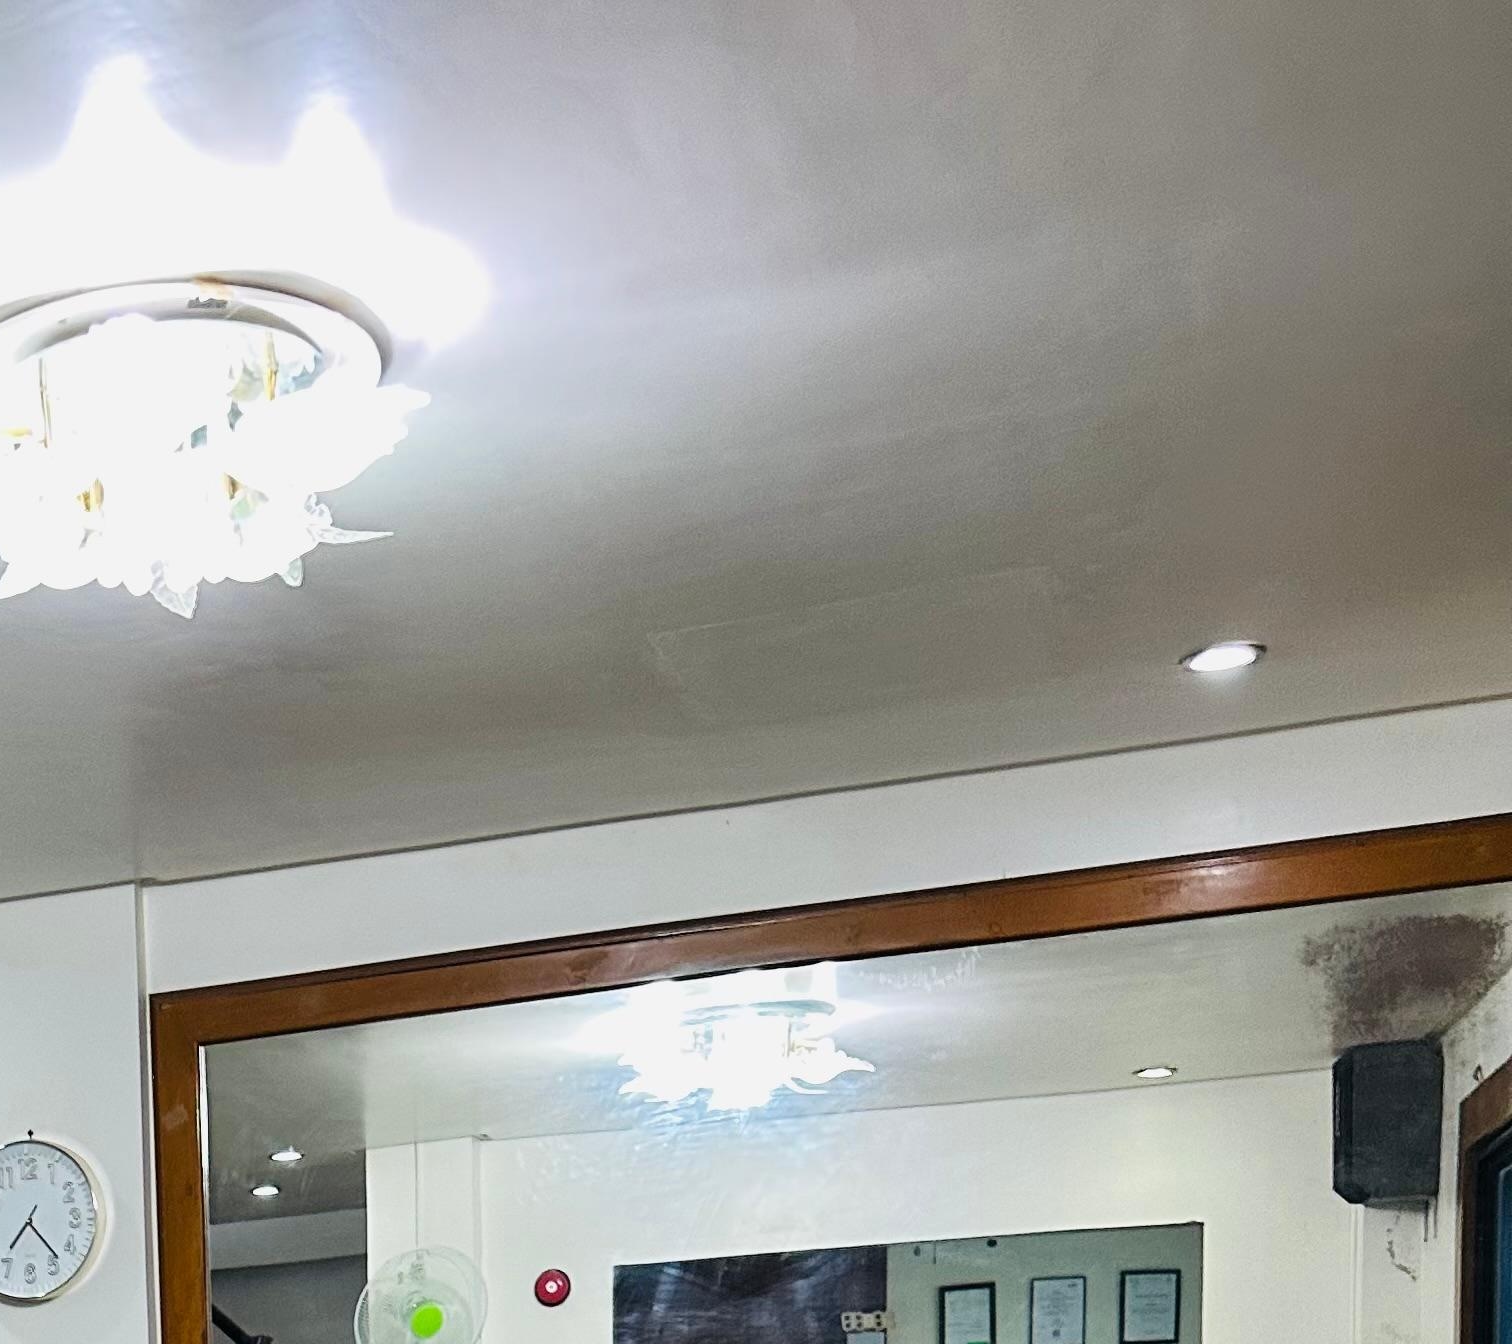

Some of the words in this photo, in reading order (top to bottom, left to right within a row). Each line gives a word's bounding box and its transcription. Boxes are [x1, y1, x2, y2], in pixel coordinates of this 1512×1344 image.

[18, 1157, 38, 1180] 12
[48, 1163, 55, 1185] 1
[62, 1181, 75, 1203] 2
[68, 1207, 81, 1229] 3
[63, 1233, 76, 1255] 4
[0, 1257, 14, 1279] 7
[23, 1262, 37, 1285] 6
[47, 1254, 60, 1276] 5
